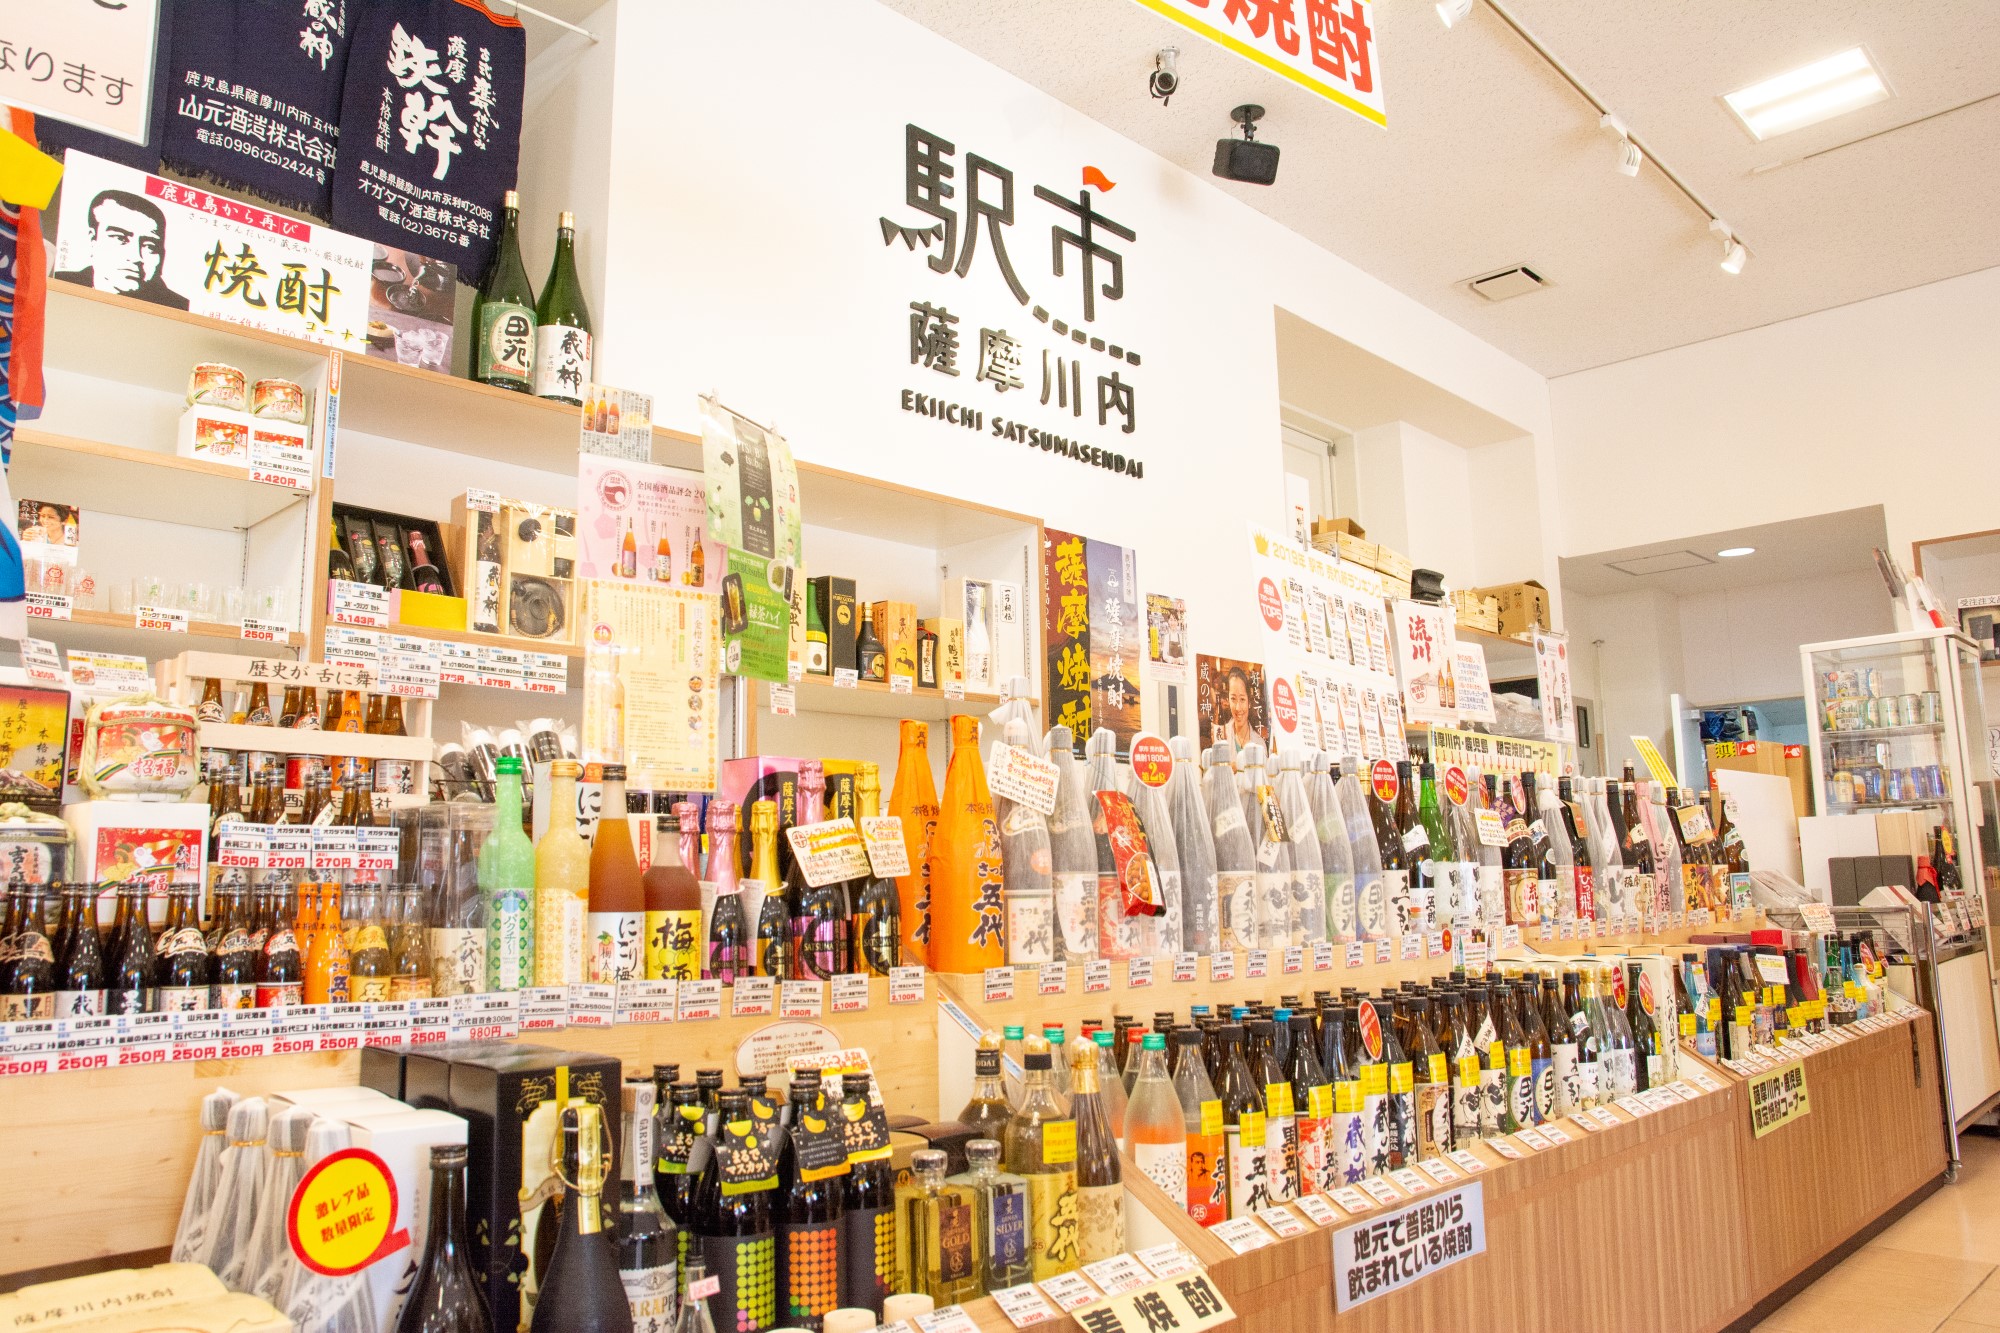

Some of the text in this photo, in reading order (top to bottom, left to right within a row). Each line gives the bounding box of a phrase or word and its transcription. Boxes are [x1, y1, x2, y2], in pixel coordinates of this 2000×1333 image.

[1186, 0, 1372, 93] 焼酎
[445, 35, 468, 83] 薩摩
[184, 71, 312, 125] 鹿児島県薩摩川内市
[376, 86, 393, 153] 本格焼酎
[177, 95, 338, 170] 山元酒造株式会社
[196, 128, 326, 185] 電話0996(25)2424番
[359, 160, 493, 221] 鹿児島県薩摩川内市永利町2088
[159, 183, 298, 236] 鹿児島から再び
[358, 178, 491, 240] オガタマ酒造株式会社
[379, 206, 470, 248] 電話(22)3675番
[879, 123, 1137, 322] 駅市
[204, 240, 342, 324] 焼酎
[305, 321, 373, 345] コーナー
[502, 316, 530, 368] 田苑
[557, 330, 583, 394] 蔵の神
[910, 301, 1136, 434] 薩摩川内
[902, 389, 1144, 479] EKIICHI SATSUMASENDAI
[253, 472, 296, 487] 2,420円
[336, 613, 375, 626] 3,143円
[749, 603, 781, 625] 緑茶ハイ
[1261, 604, 1283, 622] TOP5
[139, 620, 171, 631] 350円
[244, 630, 273, 641] 250円
[1409, 615, 1432, 663] 流川
[1105, 598, 1126, 710] 薩摩焼酎
[248, 660, 378, 689] 歴史が 舌に舞
[478, 678, 511, 688] 1,875円
[391, 684, 424, 696] 3,980円
[524, 683, 555, 693] 1,875円
[1200, 664, 1214, 722] 蔵の神。
[17, 698, 28, 734] 歴史が
[34, 728, 49, 781] 本格焼酎
[132, 758, 177, 777] 招福
[221, 855, 259, 867] 250円
[268, 856, 305, 867] 270円
[315, 856, 351, 868] 270円
[358, 858, 393, 869] 270円
[891, 993, 916, 1001] 2,100円
[833, 1002, 860, 1010] 2,100円
[75, 1019, 110, 1029] 山元酒造
[135, 1014, 168, 1025] 山元酒造
[187, 1013, 220, 1022] 山元酒造
[236, 1011, 267, 1020] 山元酒造
[457, 1016, 513, 1026] 六代目百合300ml
[628, 1011, 660, 1021] 1680円
[16, 1024, 52, 1033] 山元酒造
[470, 1025, 501, 1040] 980円
[320, 1038, 358, 1049] 250円
[365, 1036, 402, 1047] 250円
[411, 1032, 446, 1043] 250円
[173, 1047, 216, 1060] 250円
[222, 1044, 263, 1057] 250円
[273, 1040, 313, 1053] 250円
[58, 1055, 107, 1070] 250円
[119, 1049, 166, 1065] 250円
[0, 1060, 47, 1074] 250円
[1753, 1068, 1803, 1107] 薩摩川内・鹿児島
[1756, 1094, 1806, 1129] 限定焼酎コーナー
[639, 1118, 649, 1166] GARAPPA
[732, 1147, 761, 1164] まるで
[726, 1160, 771, 1176] マスカット
[314, 1183, 371, 1221] 激レア品
[1193, 1207, 1205, 1218] 25
[320, 1207, 376, 1246] 数量限定
[996, 1221, 1025, 1236] SILVER
[1354, 1194, 1464, 1263] 地元で普段から
[942, 1233, 970, 1250] GOLD
[1032, 1240, 1044, 1250] 25
[1348, 1223, 1473, 1302] 飲まれている焼酎
[13, 1287, 175, 1327] 薩摩川内焼酎
